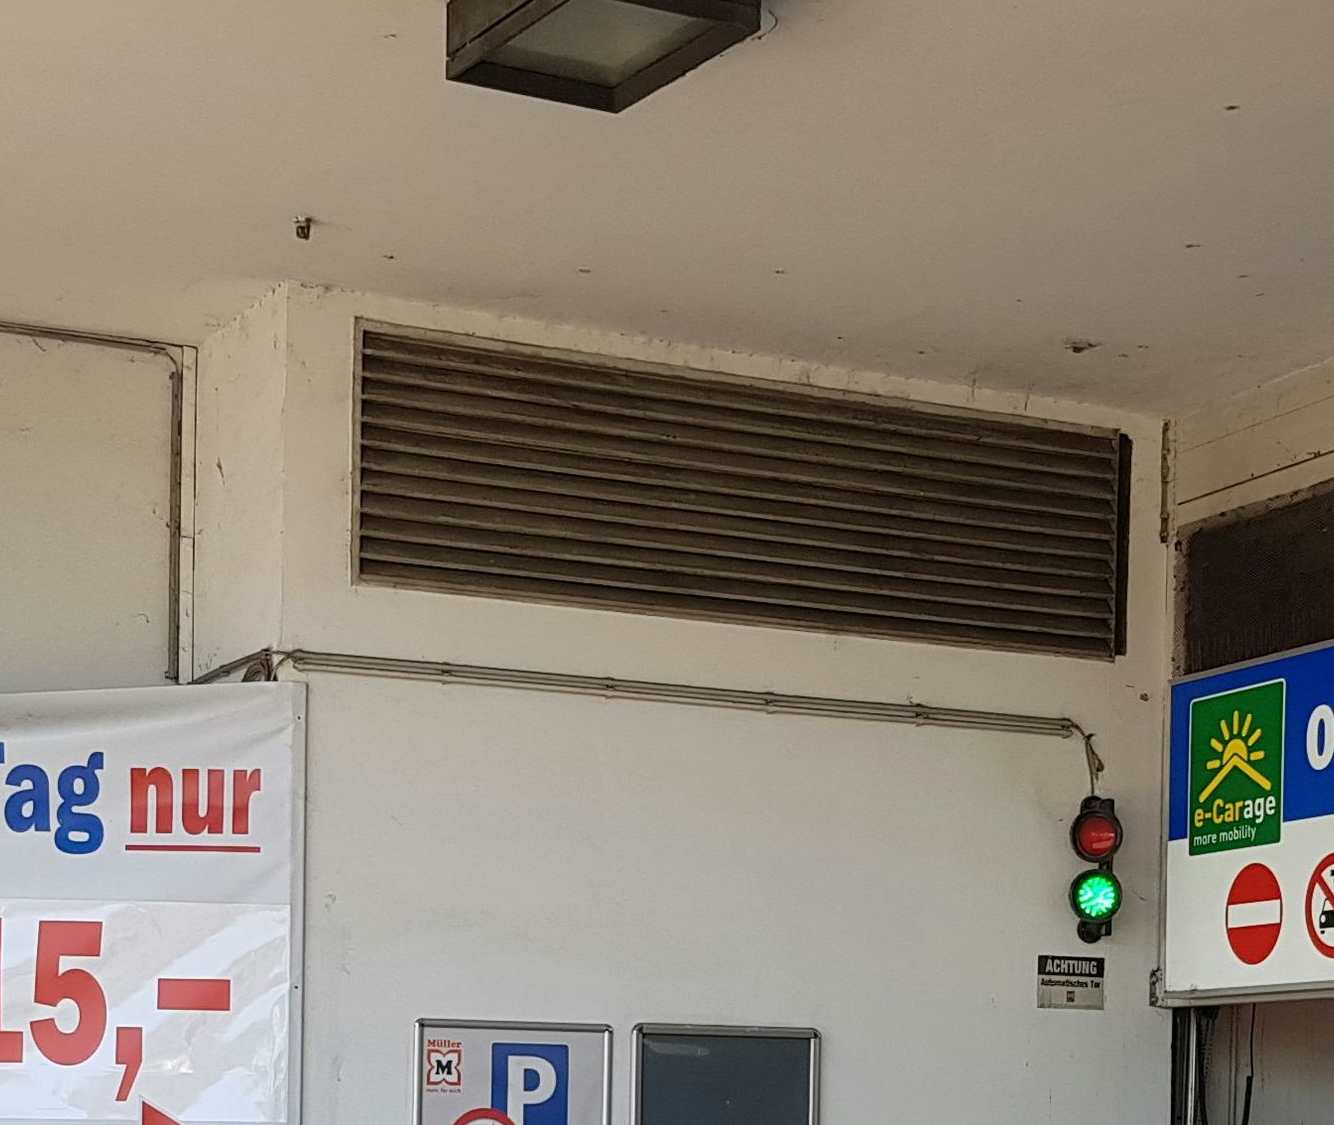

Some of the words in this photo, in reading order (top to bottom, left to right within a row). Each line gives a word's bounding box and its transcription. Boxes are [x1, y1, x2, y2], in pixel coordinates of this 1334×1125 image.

[128, 766, 262, 838] nur
[1194, 795, 1276, 828] e-Carage
[1193, 833, 1218, 846] more
[1219, 825, 1257, 844] mobility
[1045, 958, 1098, 975] ACHTUNG
[427, 1039, 462, 1048] Müller
[435, 1059, 453, 1076] M
